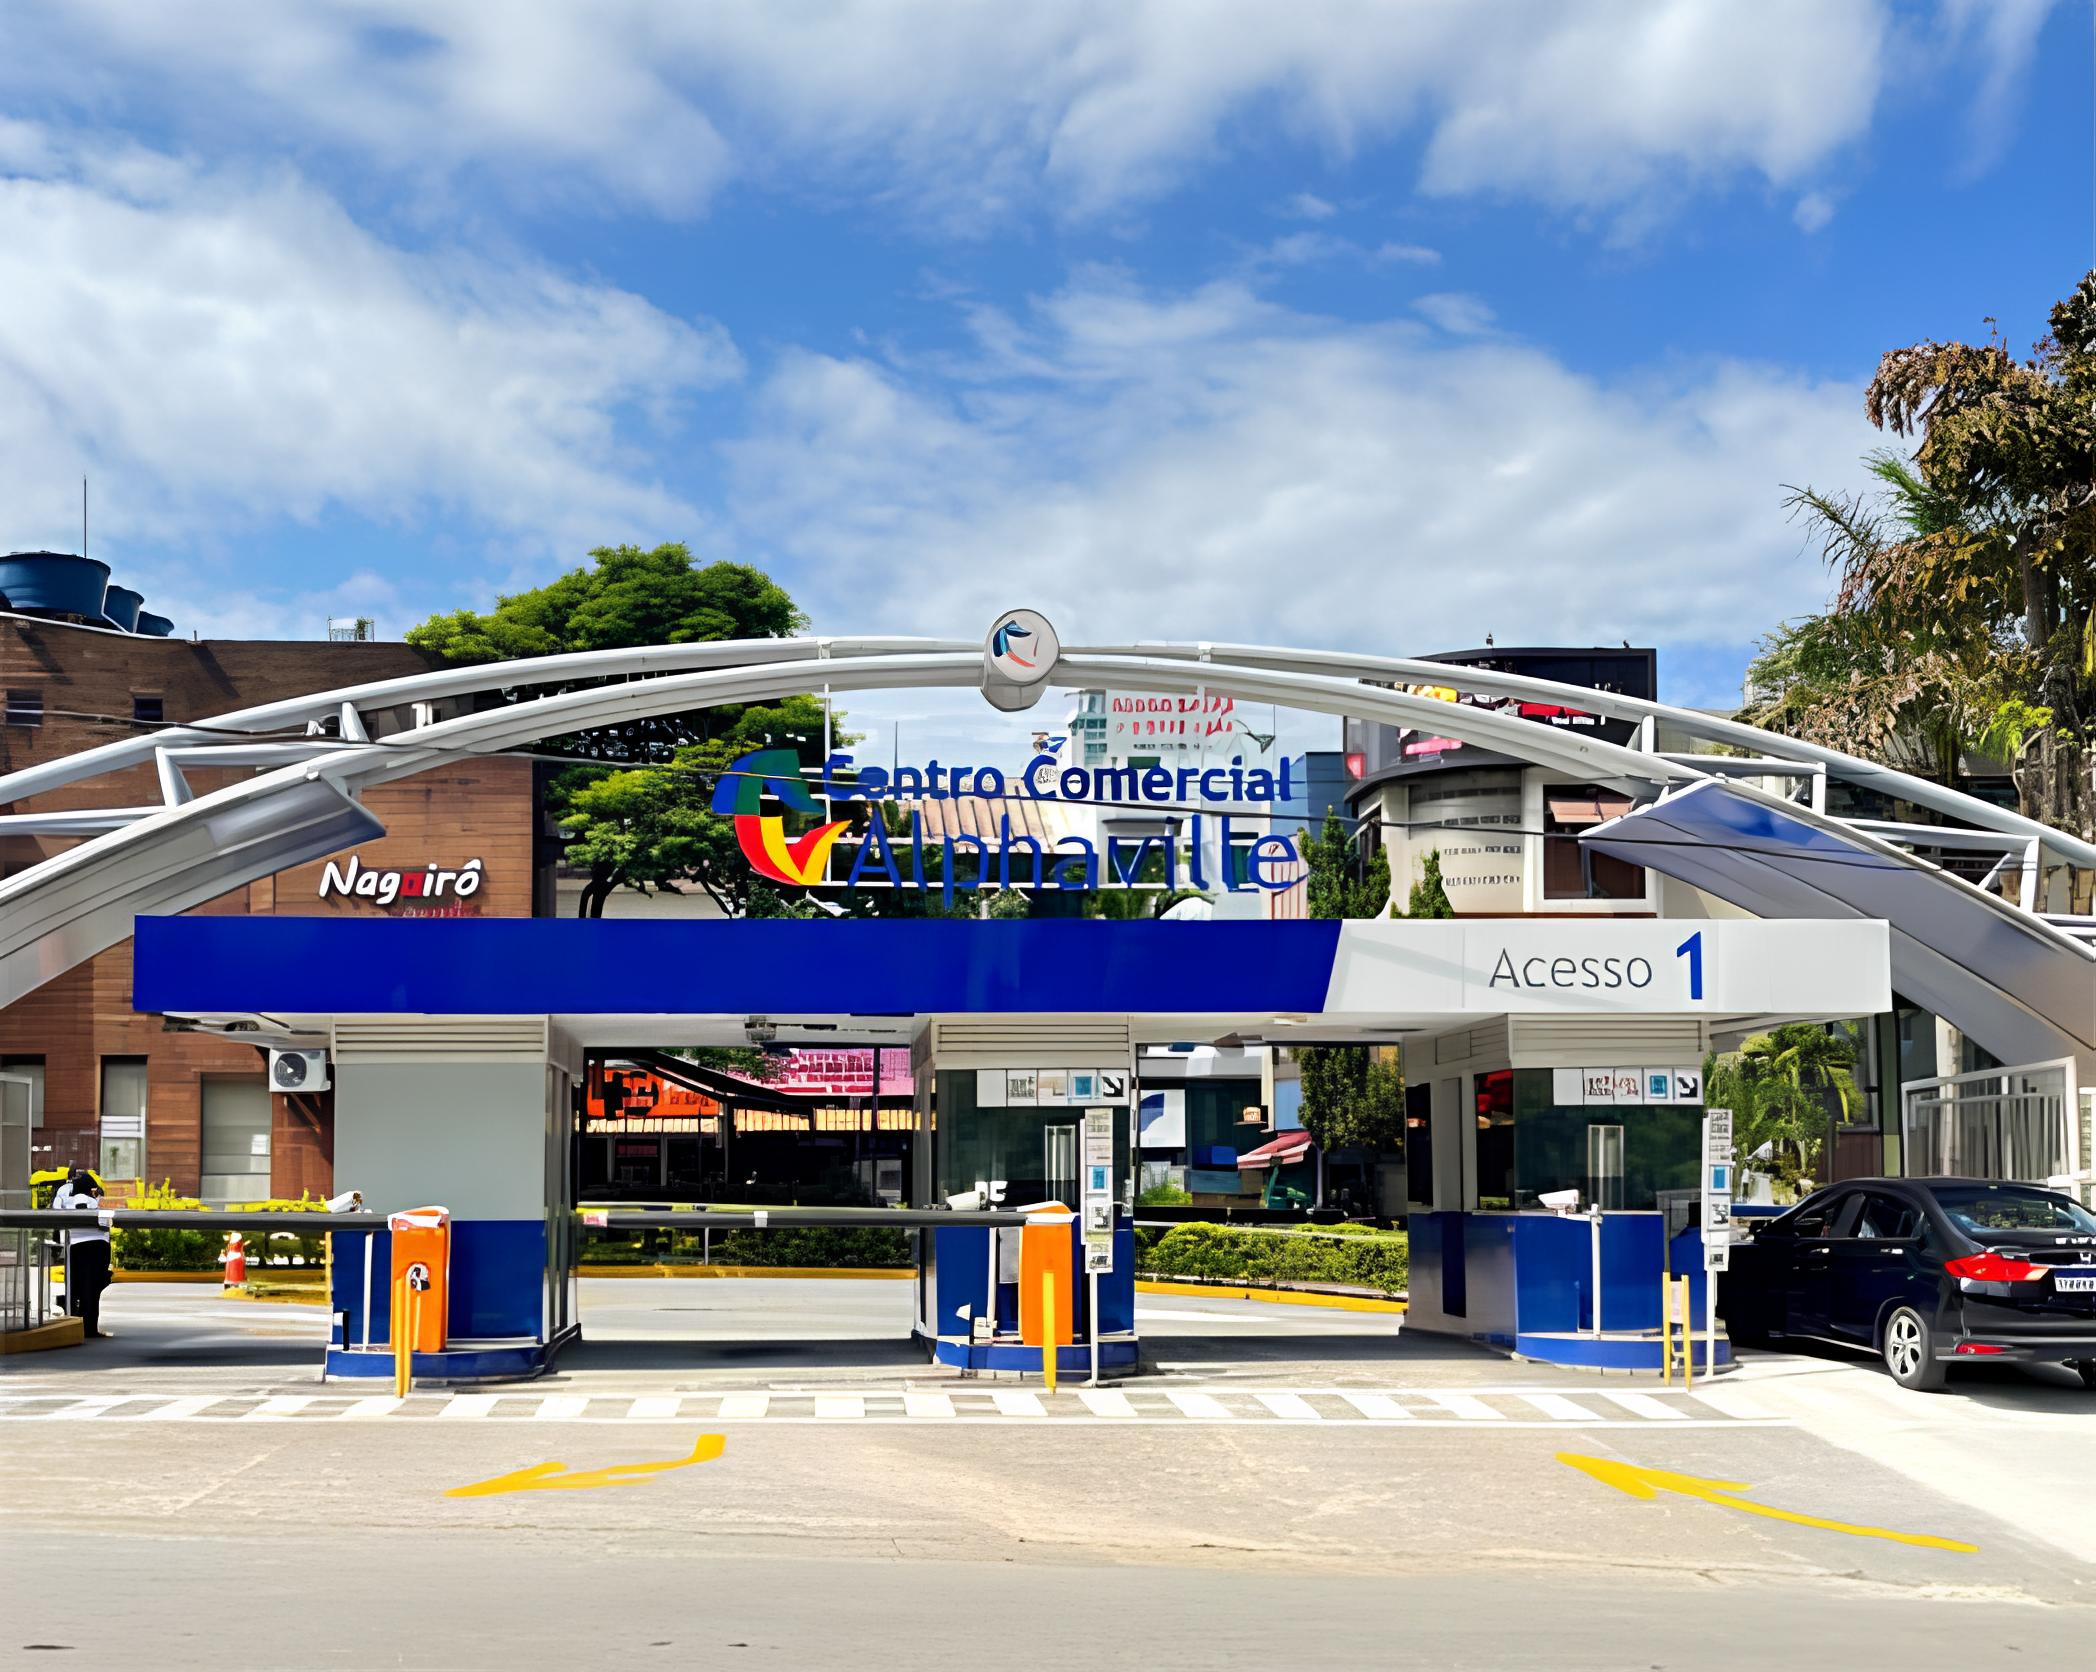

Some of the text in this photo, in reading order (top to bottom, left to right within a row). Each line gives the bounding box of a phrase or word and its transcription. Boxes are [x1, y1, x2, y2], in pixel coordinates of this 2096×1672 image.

[823, 754, 1291, 801] Centro Comercial
[847, 801, 1300, 910] Alphaville
[1488, 930, 1703, 1001] Acesso 1
